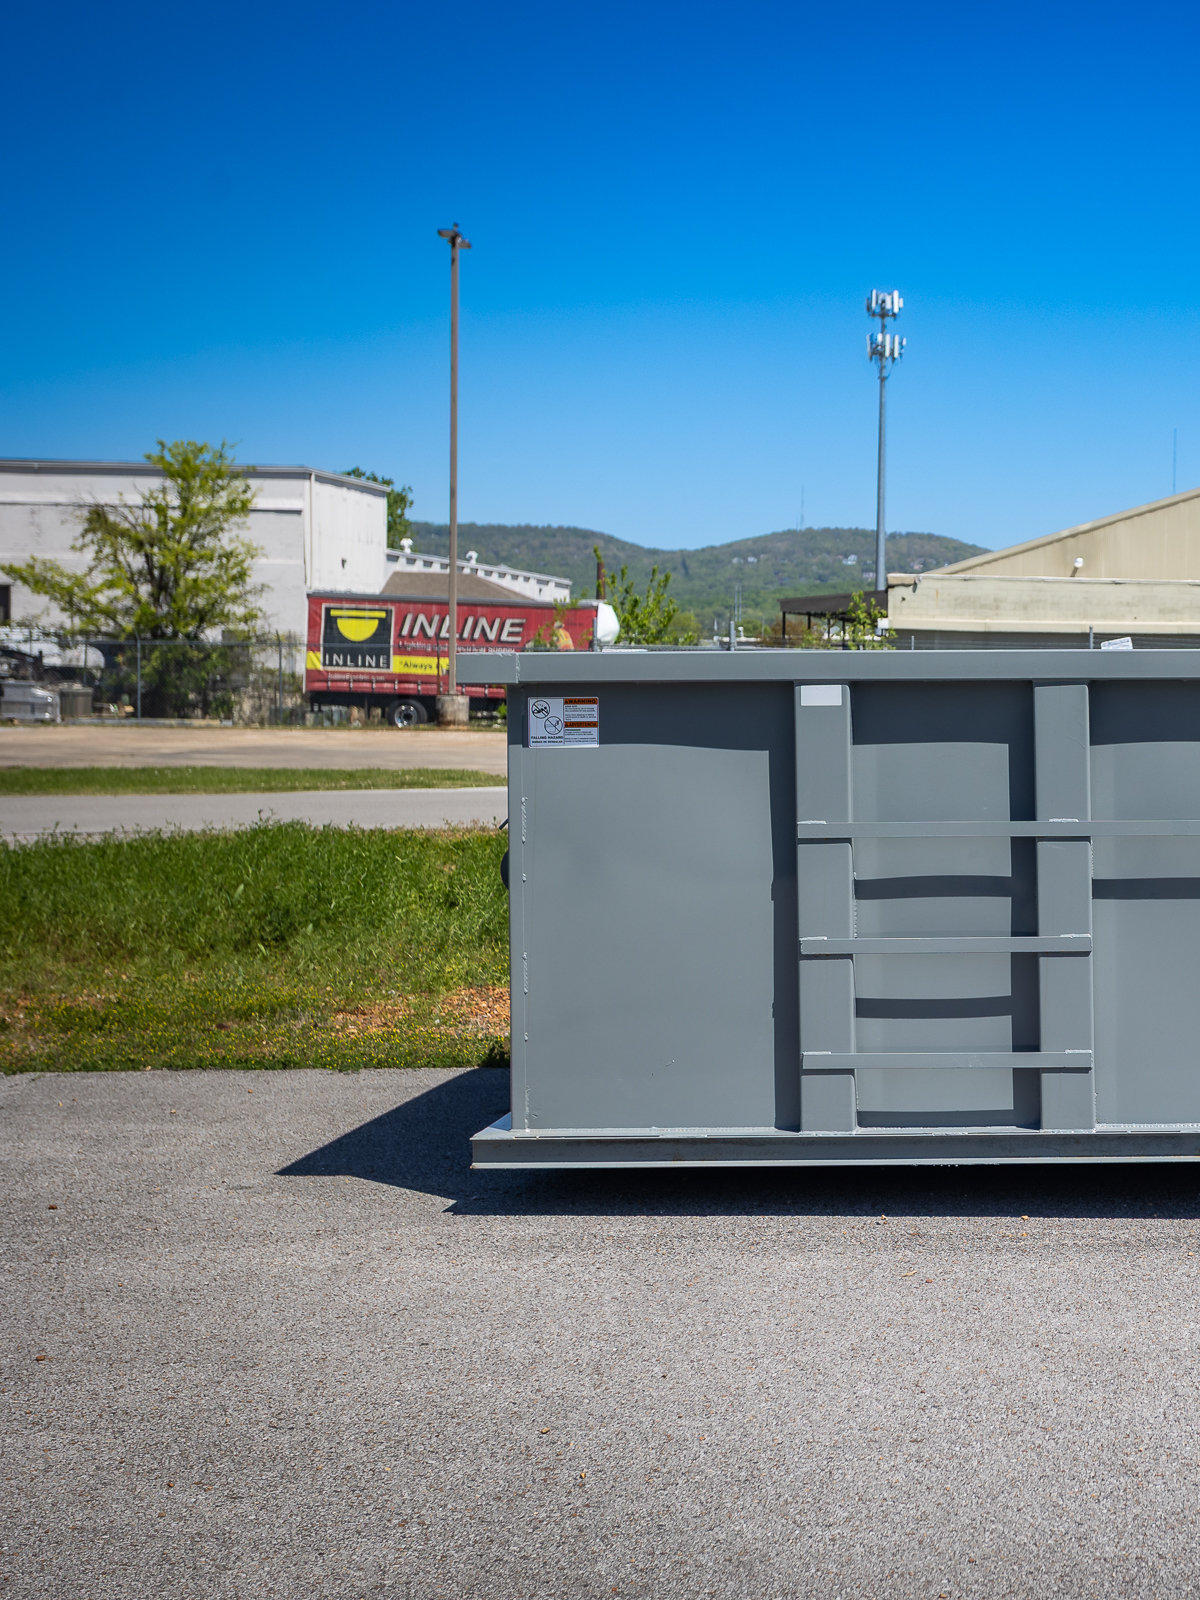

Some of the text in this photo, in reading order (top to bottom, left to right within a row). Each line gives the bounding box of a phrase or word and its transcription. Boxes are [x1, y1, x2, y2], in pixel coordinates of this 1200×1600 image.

[399, 612, 527, 643] INLINE
[399, 641, 431, 652] Lighting
[325, 653, 388, 668] INLINE
